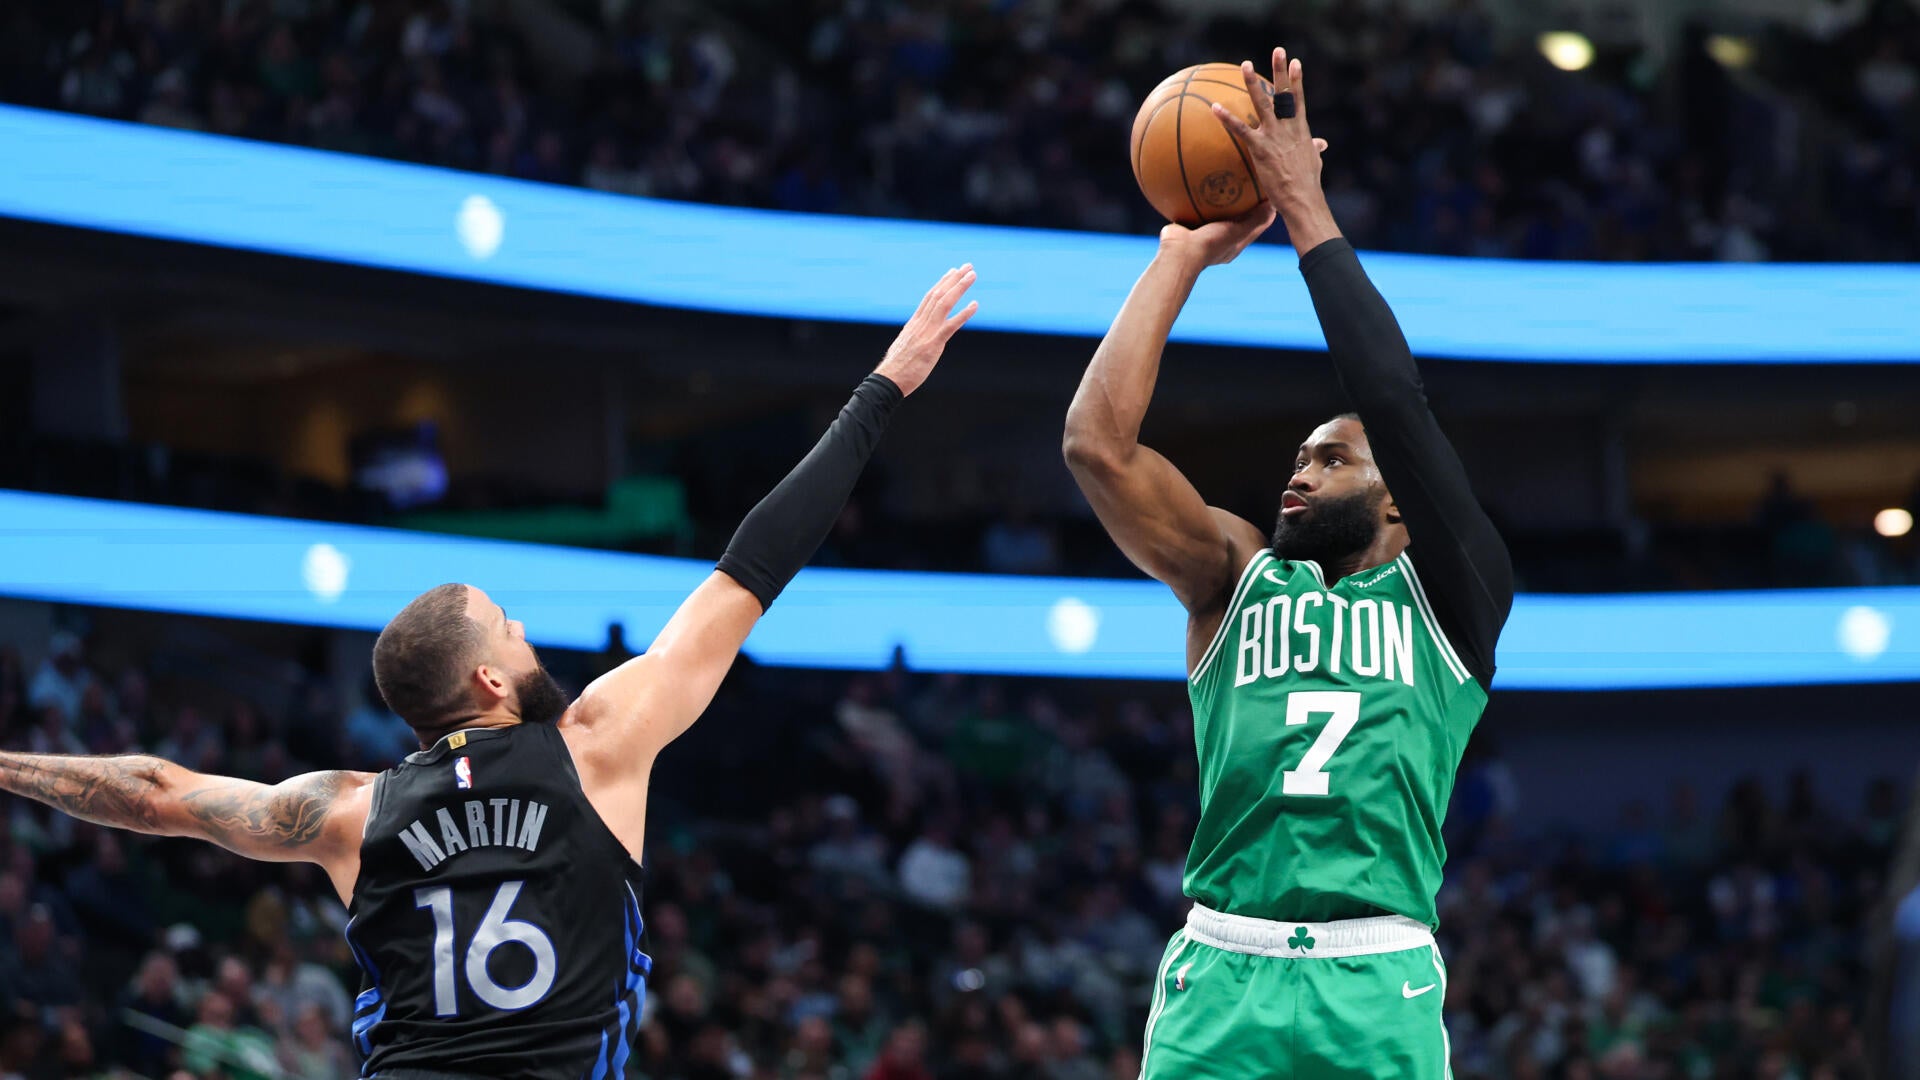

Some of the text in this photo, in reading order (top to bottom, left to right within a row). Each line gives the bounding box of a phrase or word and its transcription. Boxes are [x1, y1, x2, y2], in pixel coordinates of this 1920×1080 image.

[1350, 565, 1397, 588] Amica
[1234, 591, 1414, 687] BOSTON
[1282, 691, 1361, 795] 7
[398, 799, 548, 872] MARTIN
[413, 880, 558, 1017] 16
